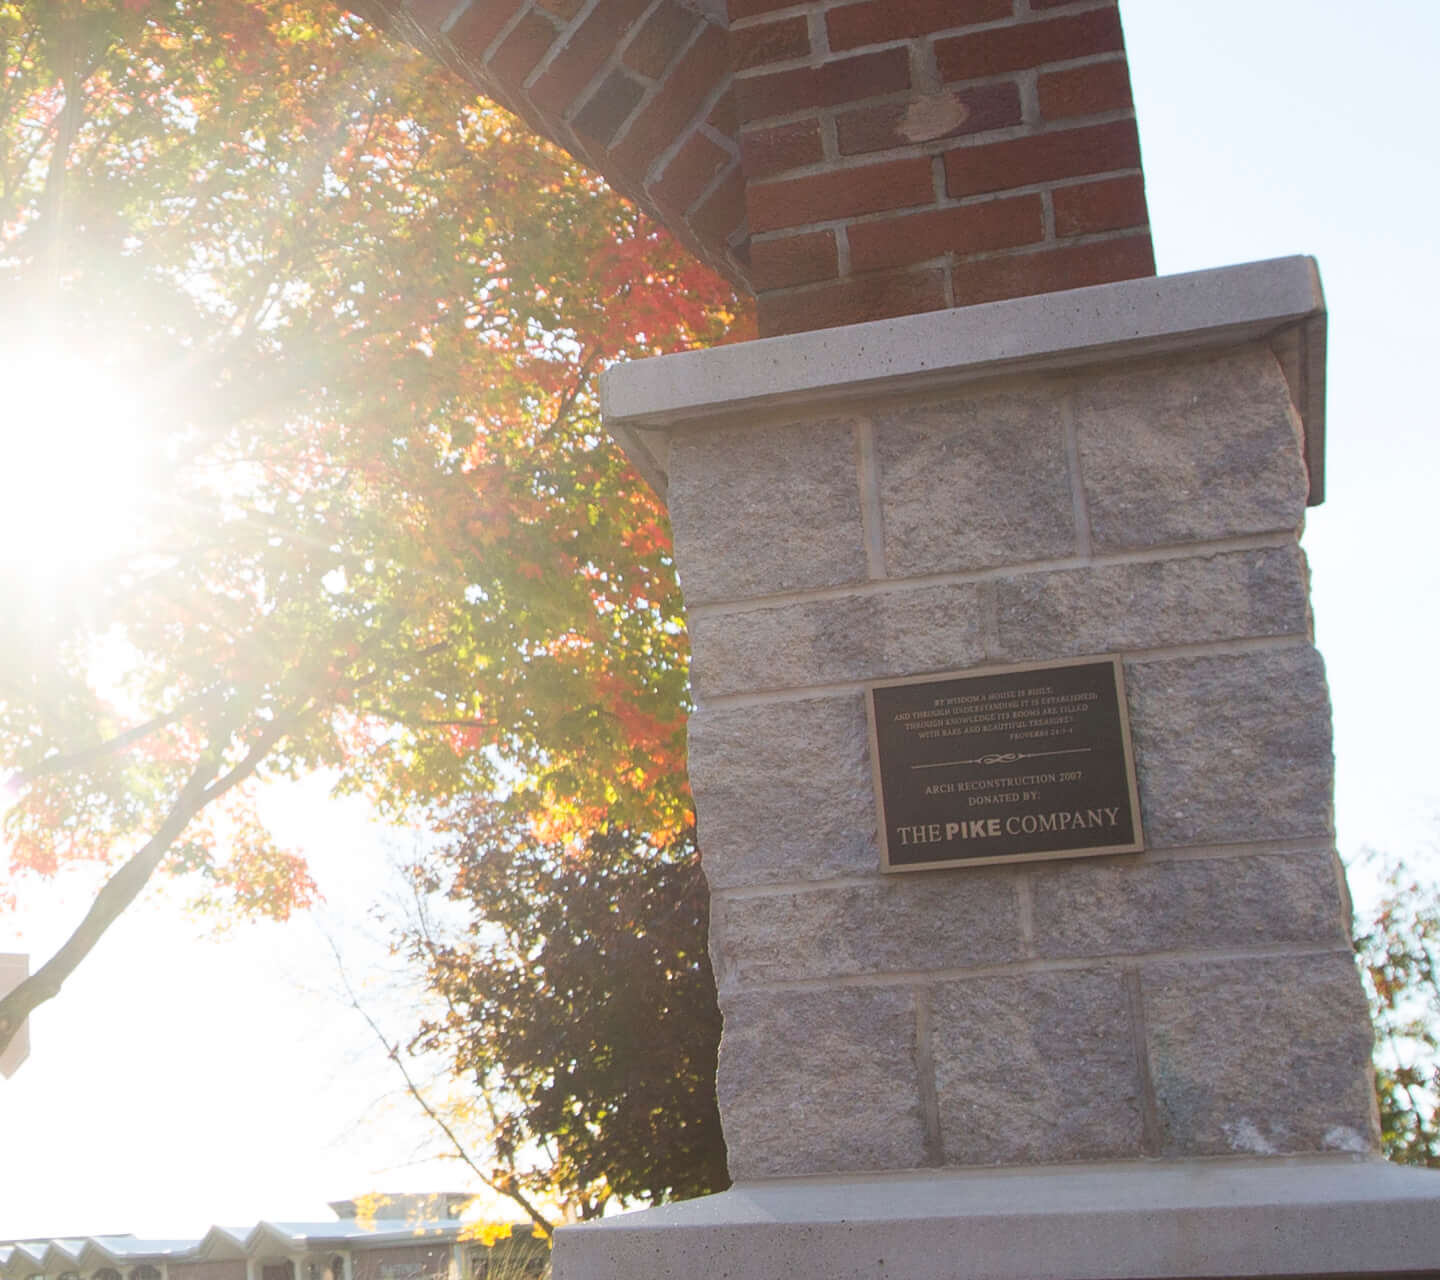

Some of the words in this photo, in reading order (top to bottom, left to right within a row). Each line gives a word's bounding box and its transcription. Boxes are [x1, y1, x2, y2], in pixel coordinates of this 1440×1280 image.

[924, 783, 955, 796] ARCH
[958, 774, 1056, 792] RECONSTRUCTION
[1059, 771, 1083, 783] 2007
[968, 794, 1020, 807] DONATED
[1022, 791, 1041, 802] BY:
[896, 824, 942, 846] THE
[945, 818, 1002, 841] PIKE
[1005, 807, 1120, 835] COMPANY
